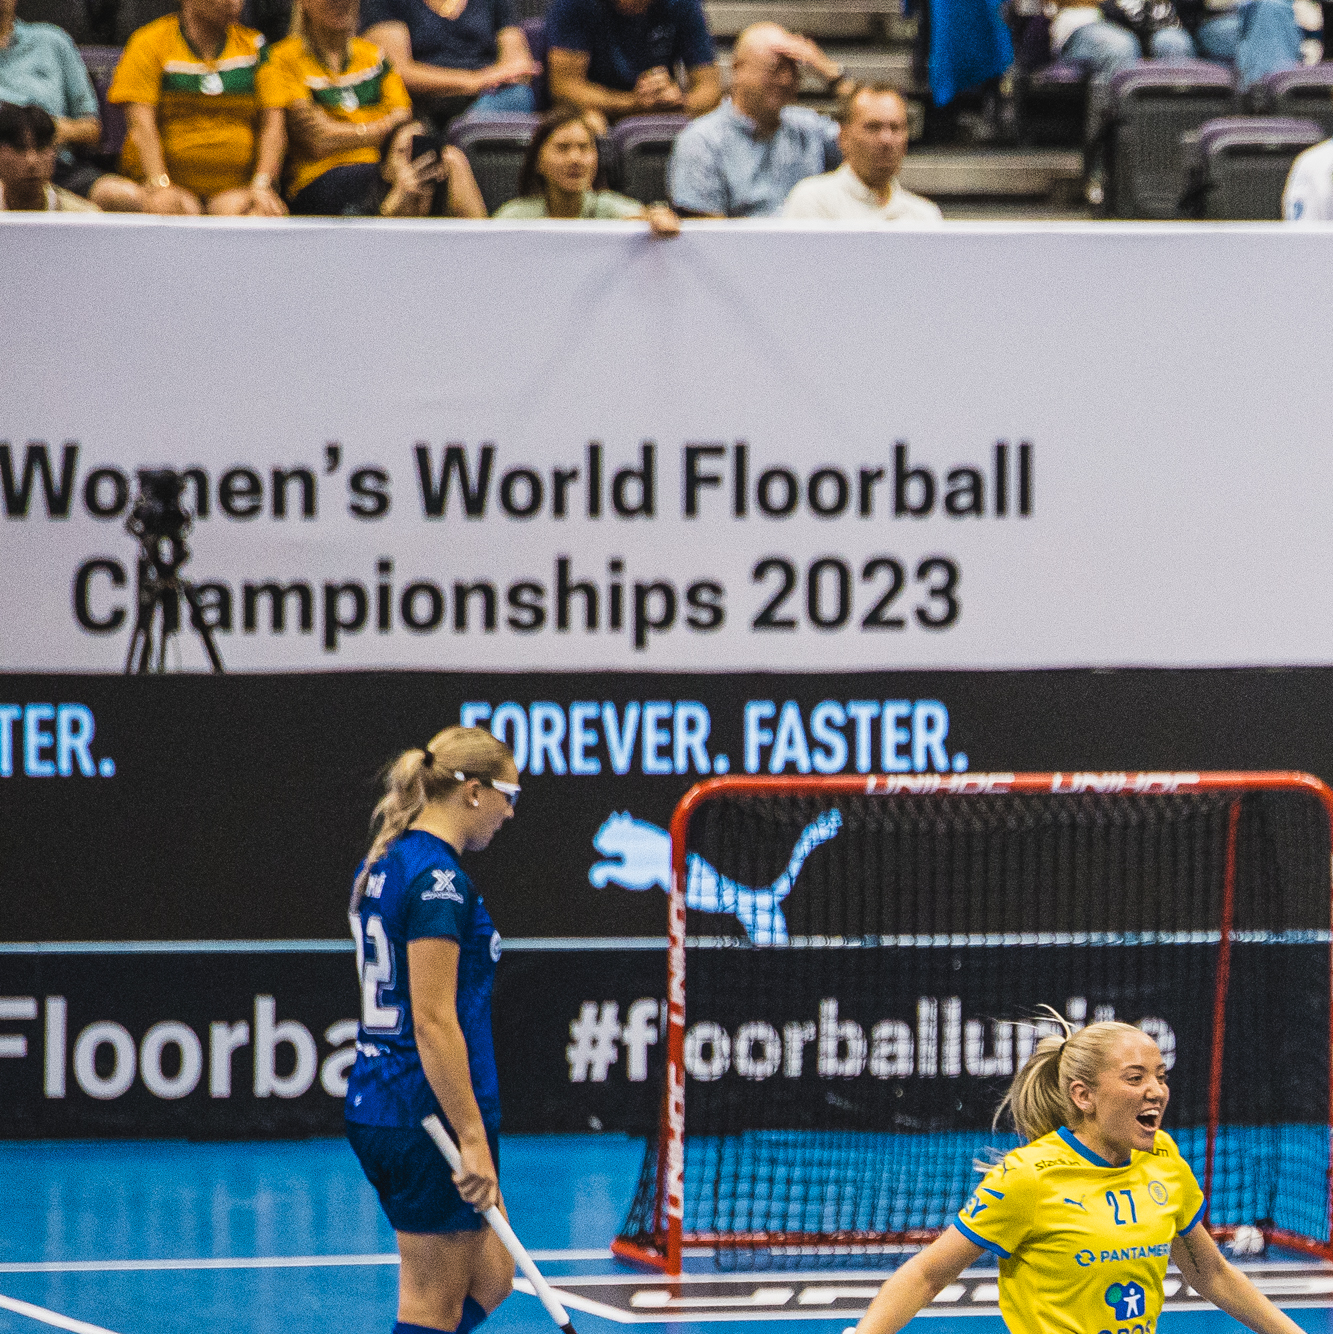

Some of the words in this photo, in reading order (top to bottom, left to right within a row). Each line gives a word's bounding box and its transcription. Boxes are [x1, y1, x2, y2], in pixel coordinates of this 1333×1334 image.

[413, 441, 656, 520] World
[682, 441, 1033, 520] Floorball
[751, 556, 960, 632] 2023
[744, 699, 969, 773] FASTER.
[1105, 1189, 1137, 1226] 27
